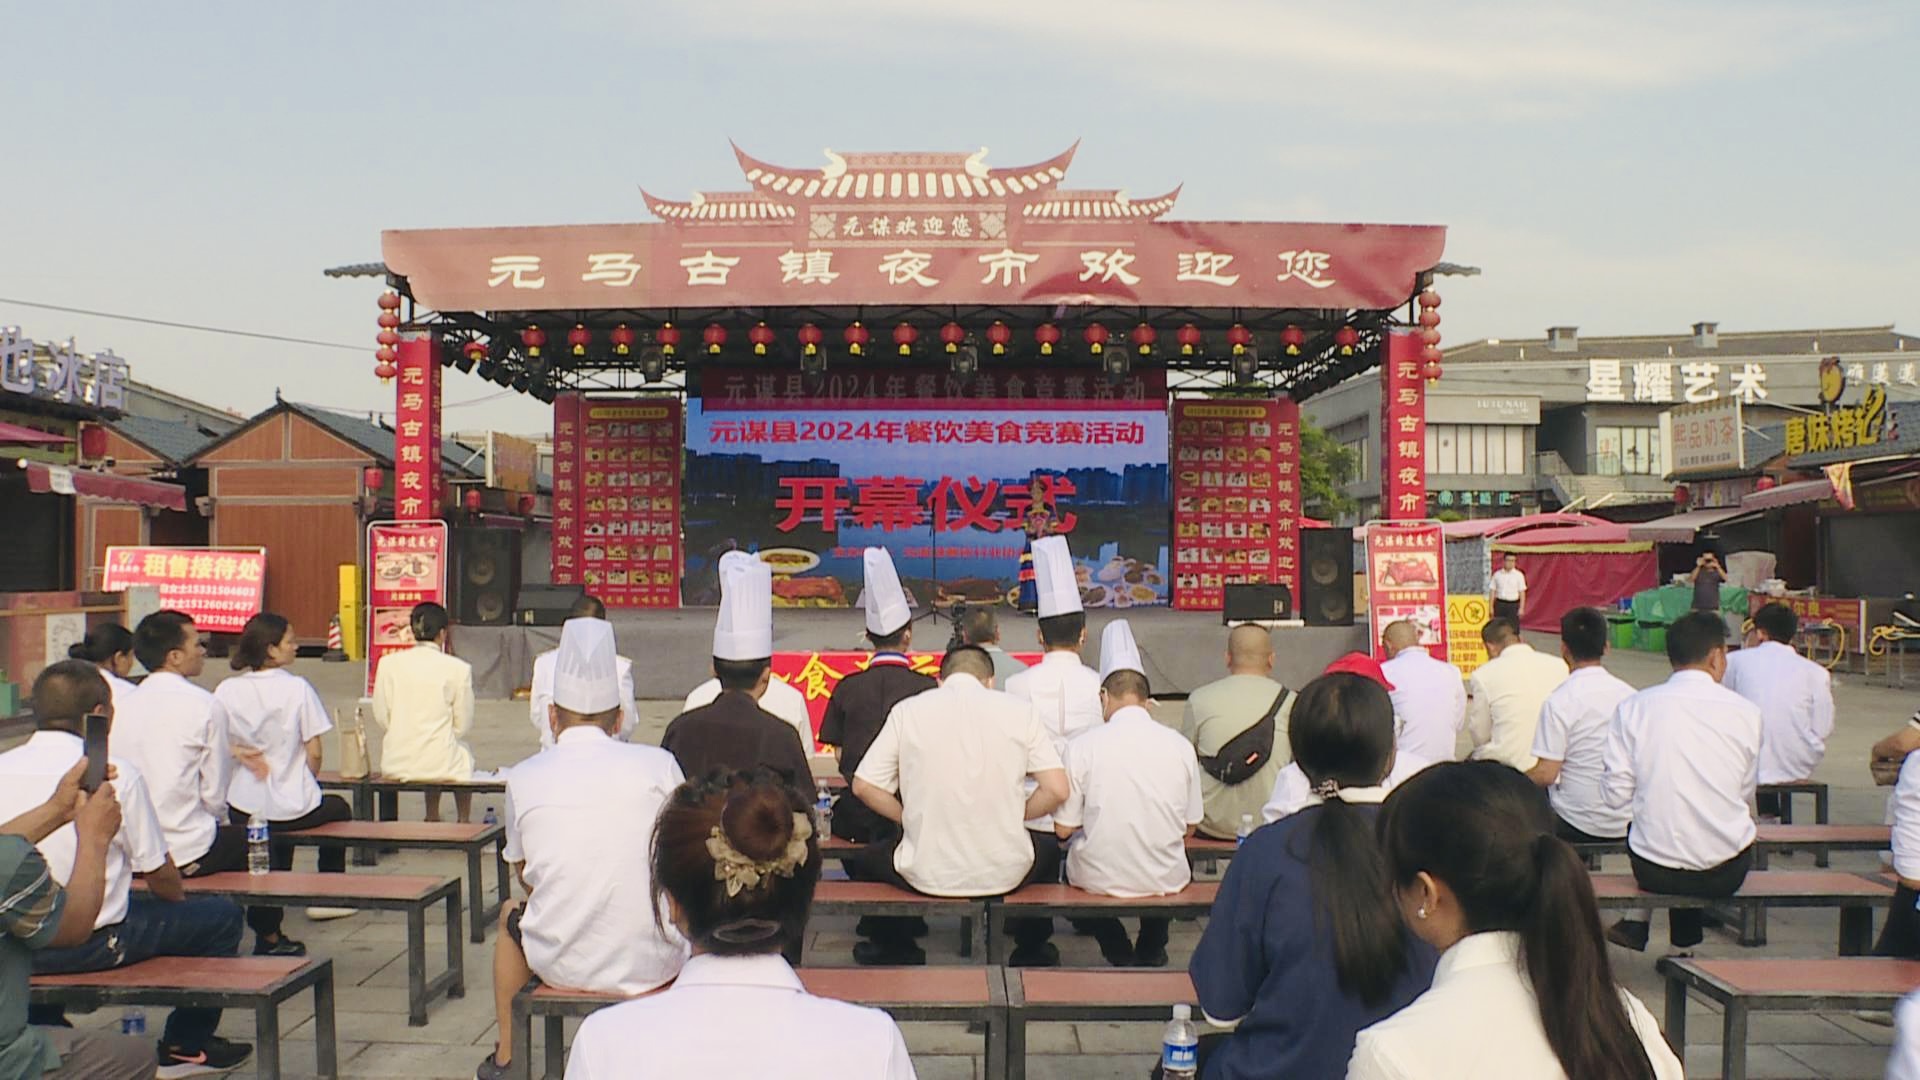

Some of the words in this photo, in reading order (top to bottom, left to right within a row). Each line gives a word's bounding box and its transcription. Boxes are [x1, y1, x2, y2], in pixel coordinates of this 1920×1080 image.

[843, 214, 973, 238] 元谋欢迎您
[487, 249, 1337, 289] 元马古镇夜市欢迎您
[1586, 359, 1769, 404] 星耀艺术
[401, 367, 424, 528] 元马古镇夜市
[709, 420, 1145, 445] 元谋县2024年餐饮美食竞赛活动
[1397, 362, 1421, 527] 元马古镇夜市
[774, 475, 1079, 535] 开幕仪式
[144, 553, 261, 581] 租售接待处
